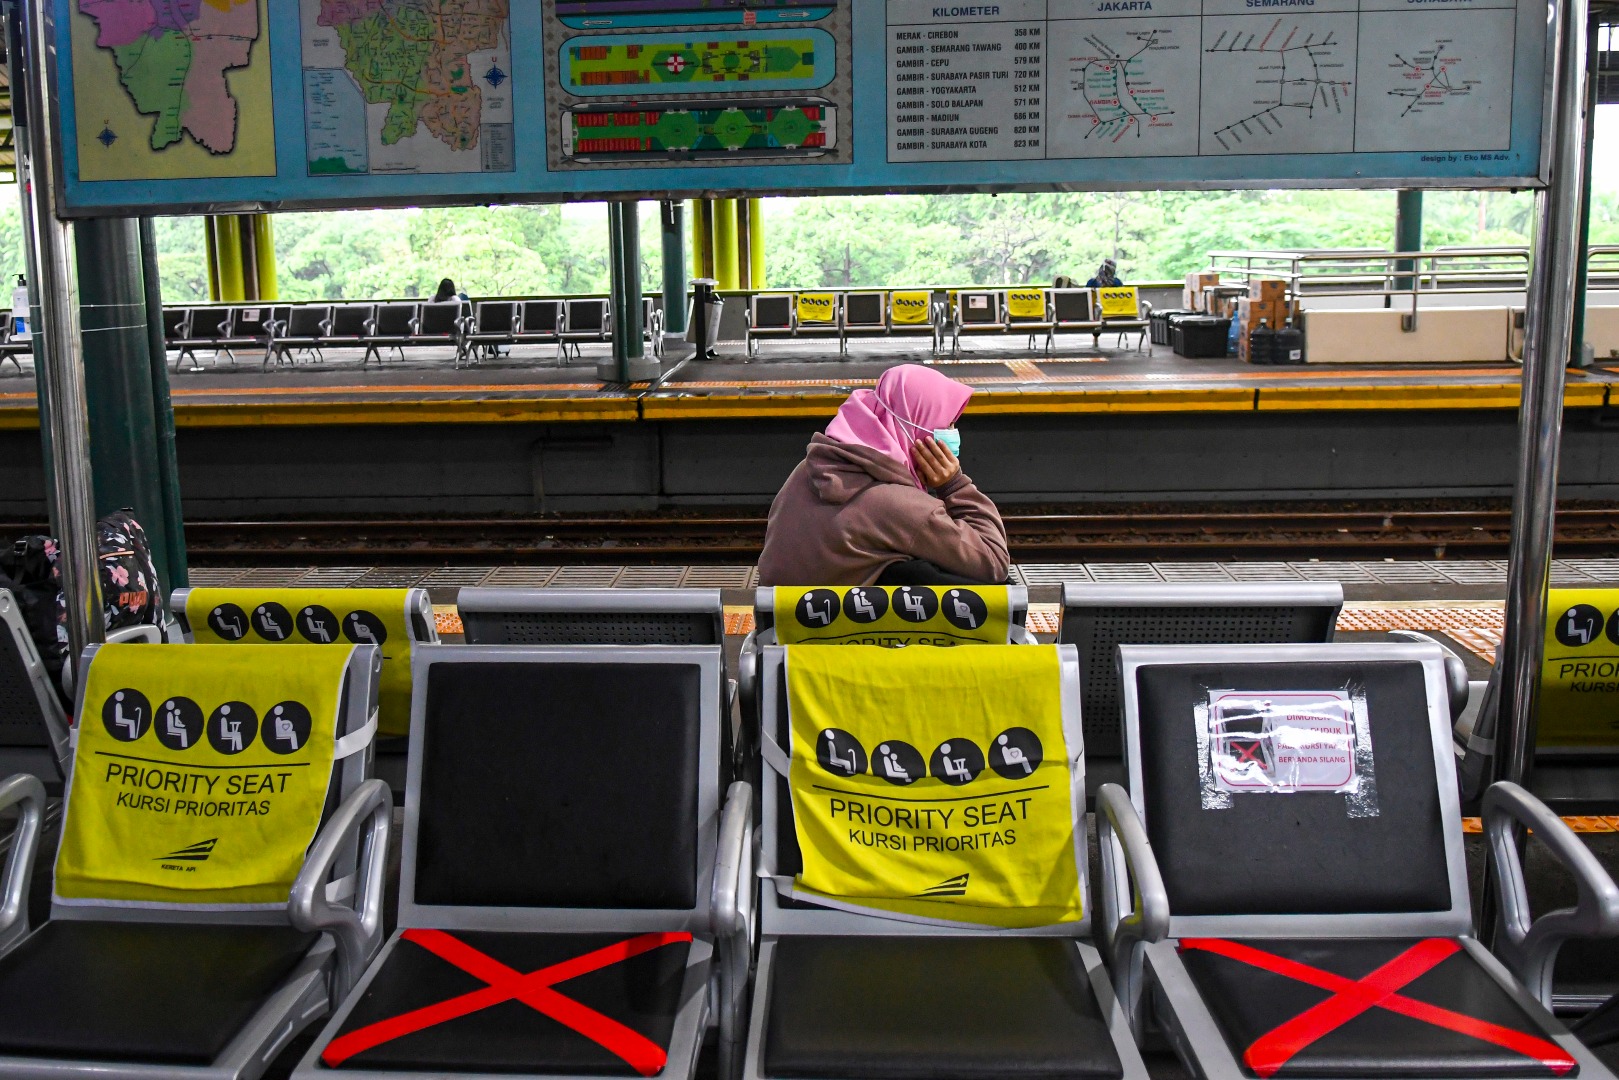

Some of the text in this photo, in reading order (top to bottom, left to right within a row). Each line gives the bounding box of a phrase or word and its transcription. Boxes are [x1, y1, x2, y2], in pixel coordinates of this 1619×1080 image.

[1098, 1, 1152, 11] JAKARTA
[932, 6, 1000, 17] KILOMETER
[897, 32, 920, 40] MERAK
[928, 31, 958, 39] CIREBON
[897, 46, 924, 54] GAMBIR
[931, 45, 970, 53] SEMARANG
[897, 60, 924, 68] GAMBIR
[931, 59, 949, 67] CEPU
[931, 73, 967, 81] SURABAYA
[897, 87, 924, 95] GAMBIR
[931, 86, 976, 94] YOGYAKARTA
[931, 114, 959, 122] MADIUN
[106, 763, 292, 795] PRIORITY SEAT
[116, 792, 270, 817] KURSI PRIORITAS
[830, 798, 1032, 829] PRIORITY SEAT
[849, 829, 1016, 851] KURSI PRIORITAS
